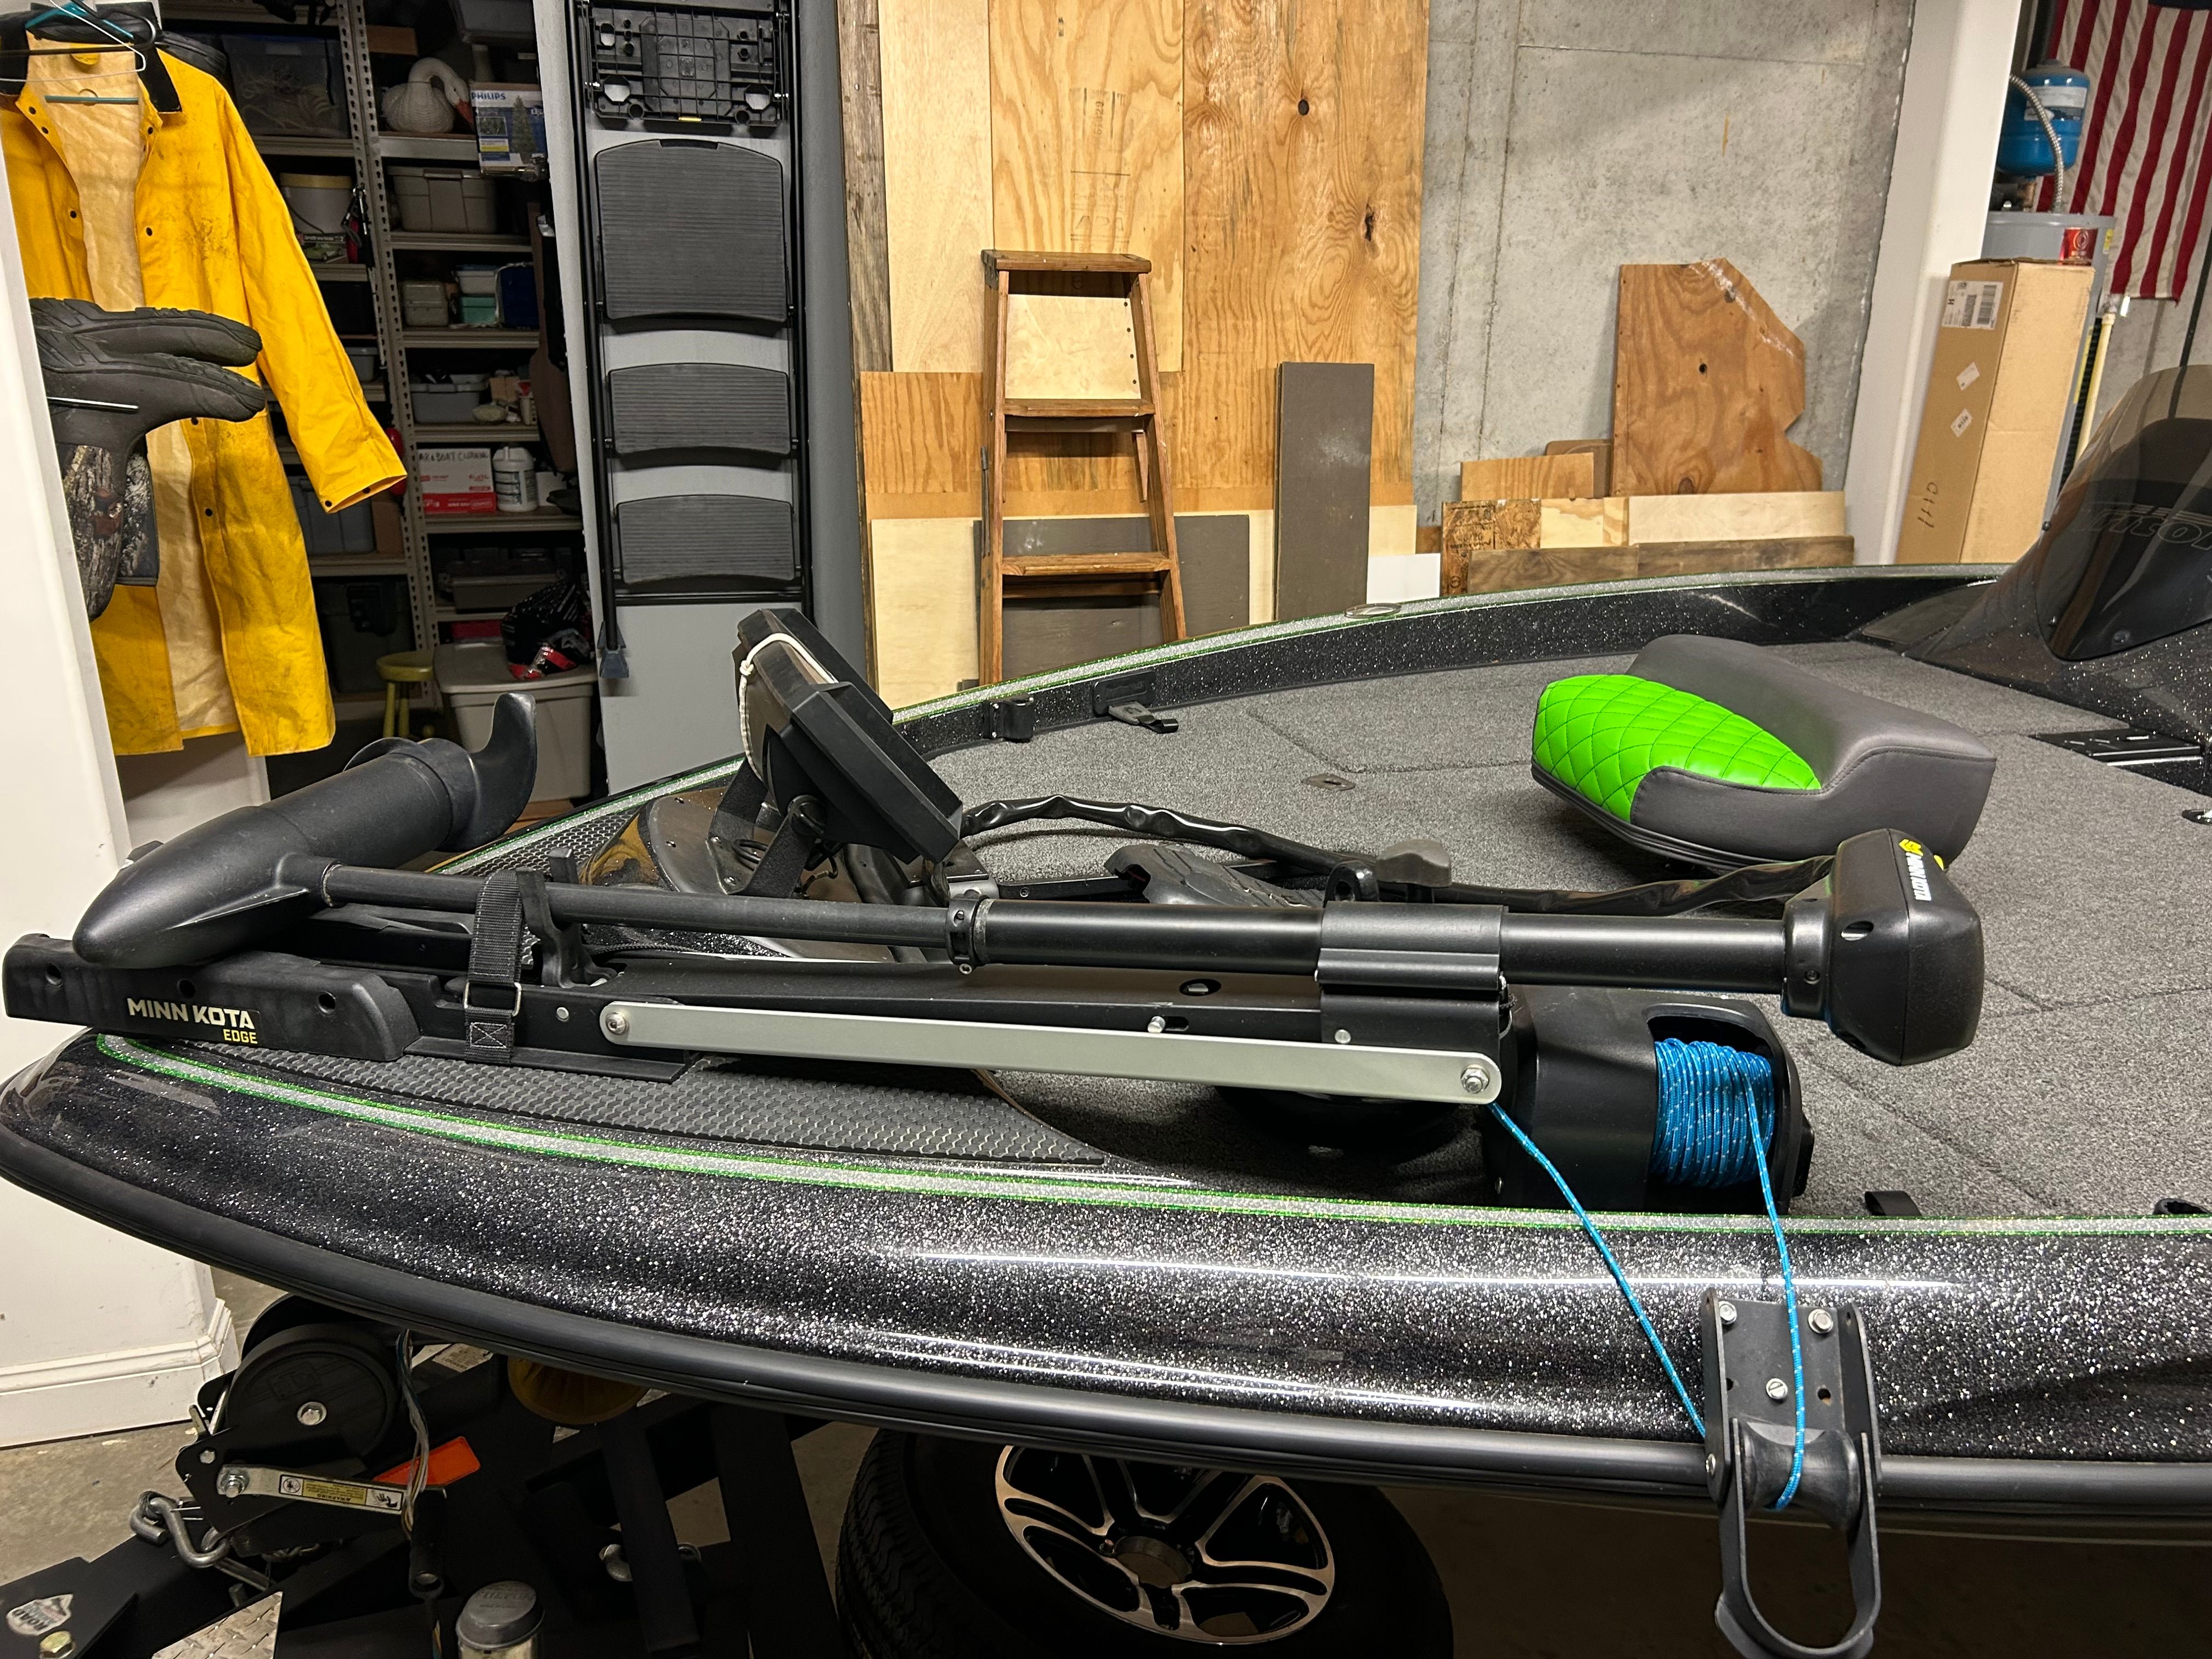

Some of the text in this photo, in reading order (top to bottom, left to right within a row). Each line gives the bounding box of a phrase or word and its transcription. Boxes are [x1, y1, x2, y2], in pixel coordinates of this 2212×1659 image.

[127, 998, 255, 1030] MINN KOTA
[223, 1029, 258, 1044] EDGE
[12, 1609, 49, 1631] ROAD
